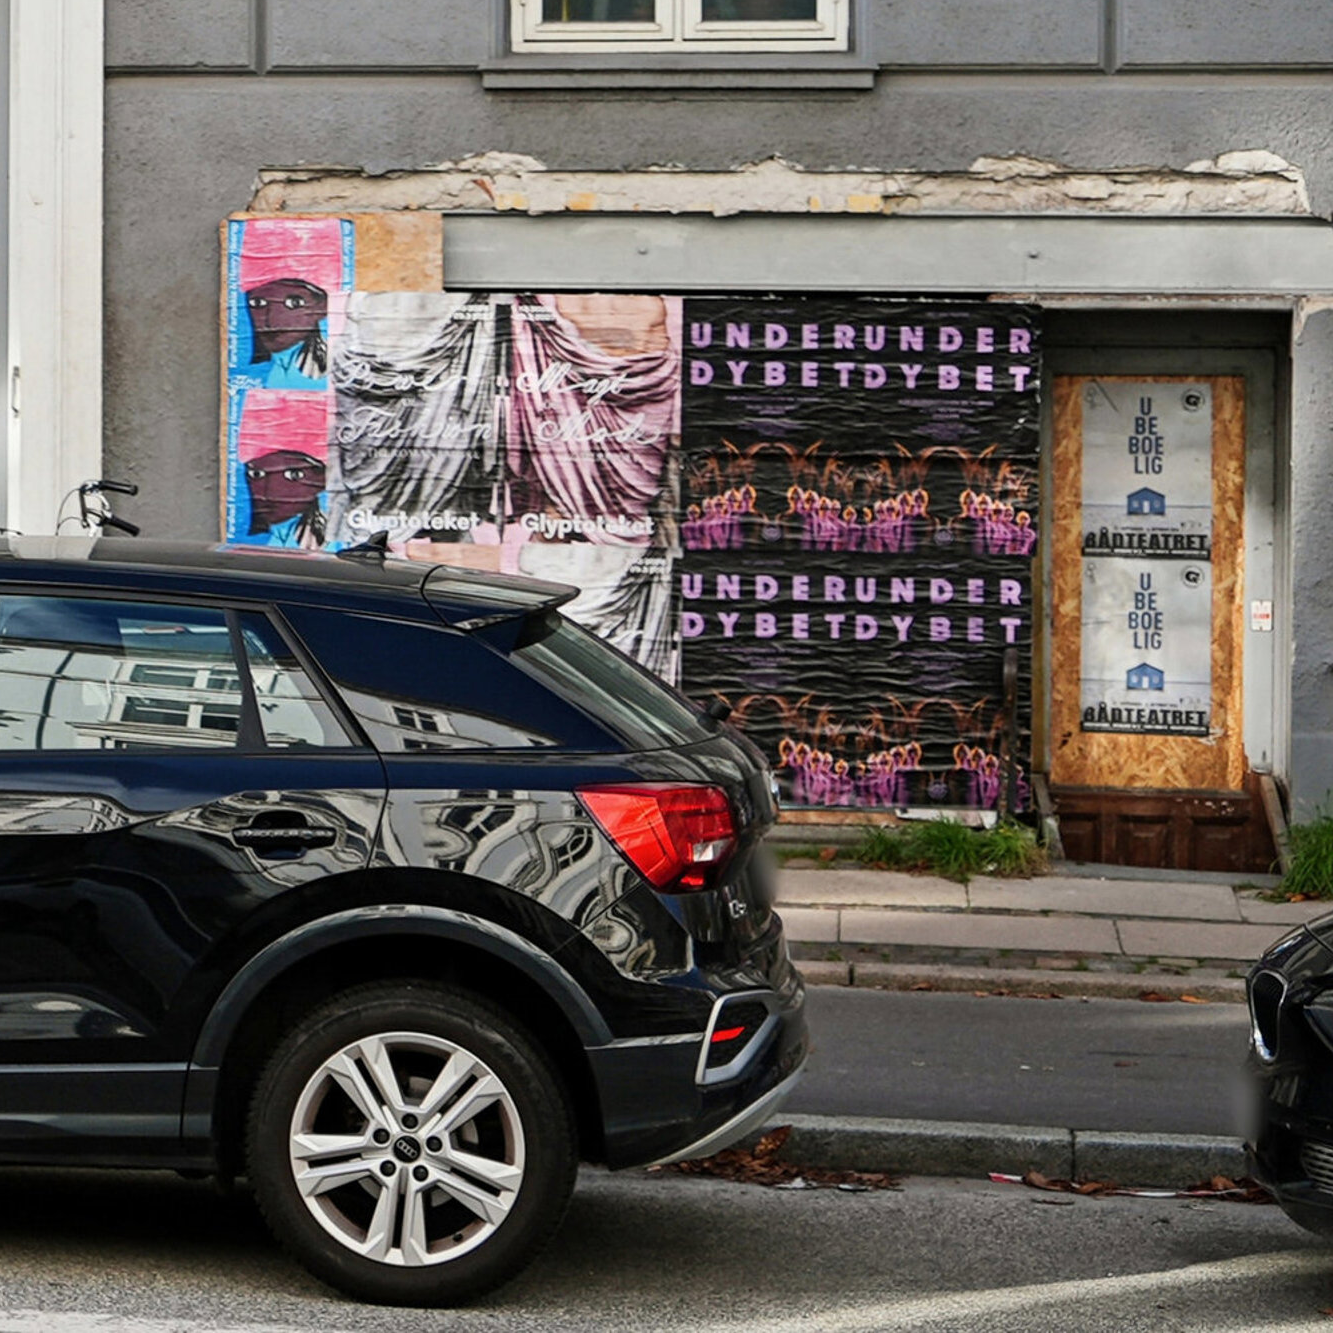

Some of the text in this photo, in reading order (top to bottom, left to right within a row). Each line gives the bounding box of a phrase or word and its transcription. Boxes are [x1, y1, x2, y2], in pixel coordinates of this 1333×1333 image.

[691, 322, 856, 350] UNDER
[864, 325, 1031, 354] UNDER
[690, 361, 856, 388] DYBET
[864, 363, 1031, 392] DYBET
[1140, 397, 1152, 416] U
[1135, 417, 1158, 435] BE
[1128, 437, 1164, 456] BOE
[1133, 456, 1162, 475] LIG
[348, 511, 481, 537] Glyptoteket
[521, 513, 655, 538] Glyptoteket
[681, 573, 846, 602] UNDER
[855, 577, 1022, 606] UNDER
[1140, 573, 1151, 592] U
[1135, 592, 1157, 611] BE
[681, 612, 846, 640] DYBET
[855, 615, 1022, 644] DYBET
[1128, 611, 1163, 630] BOE
[1133, 631, 1162, 650] LIG
